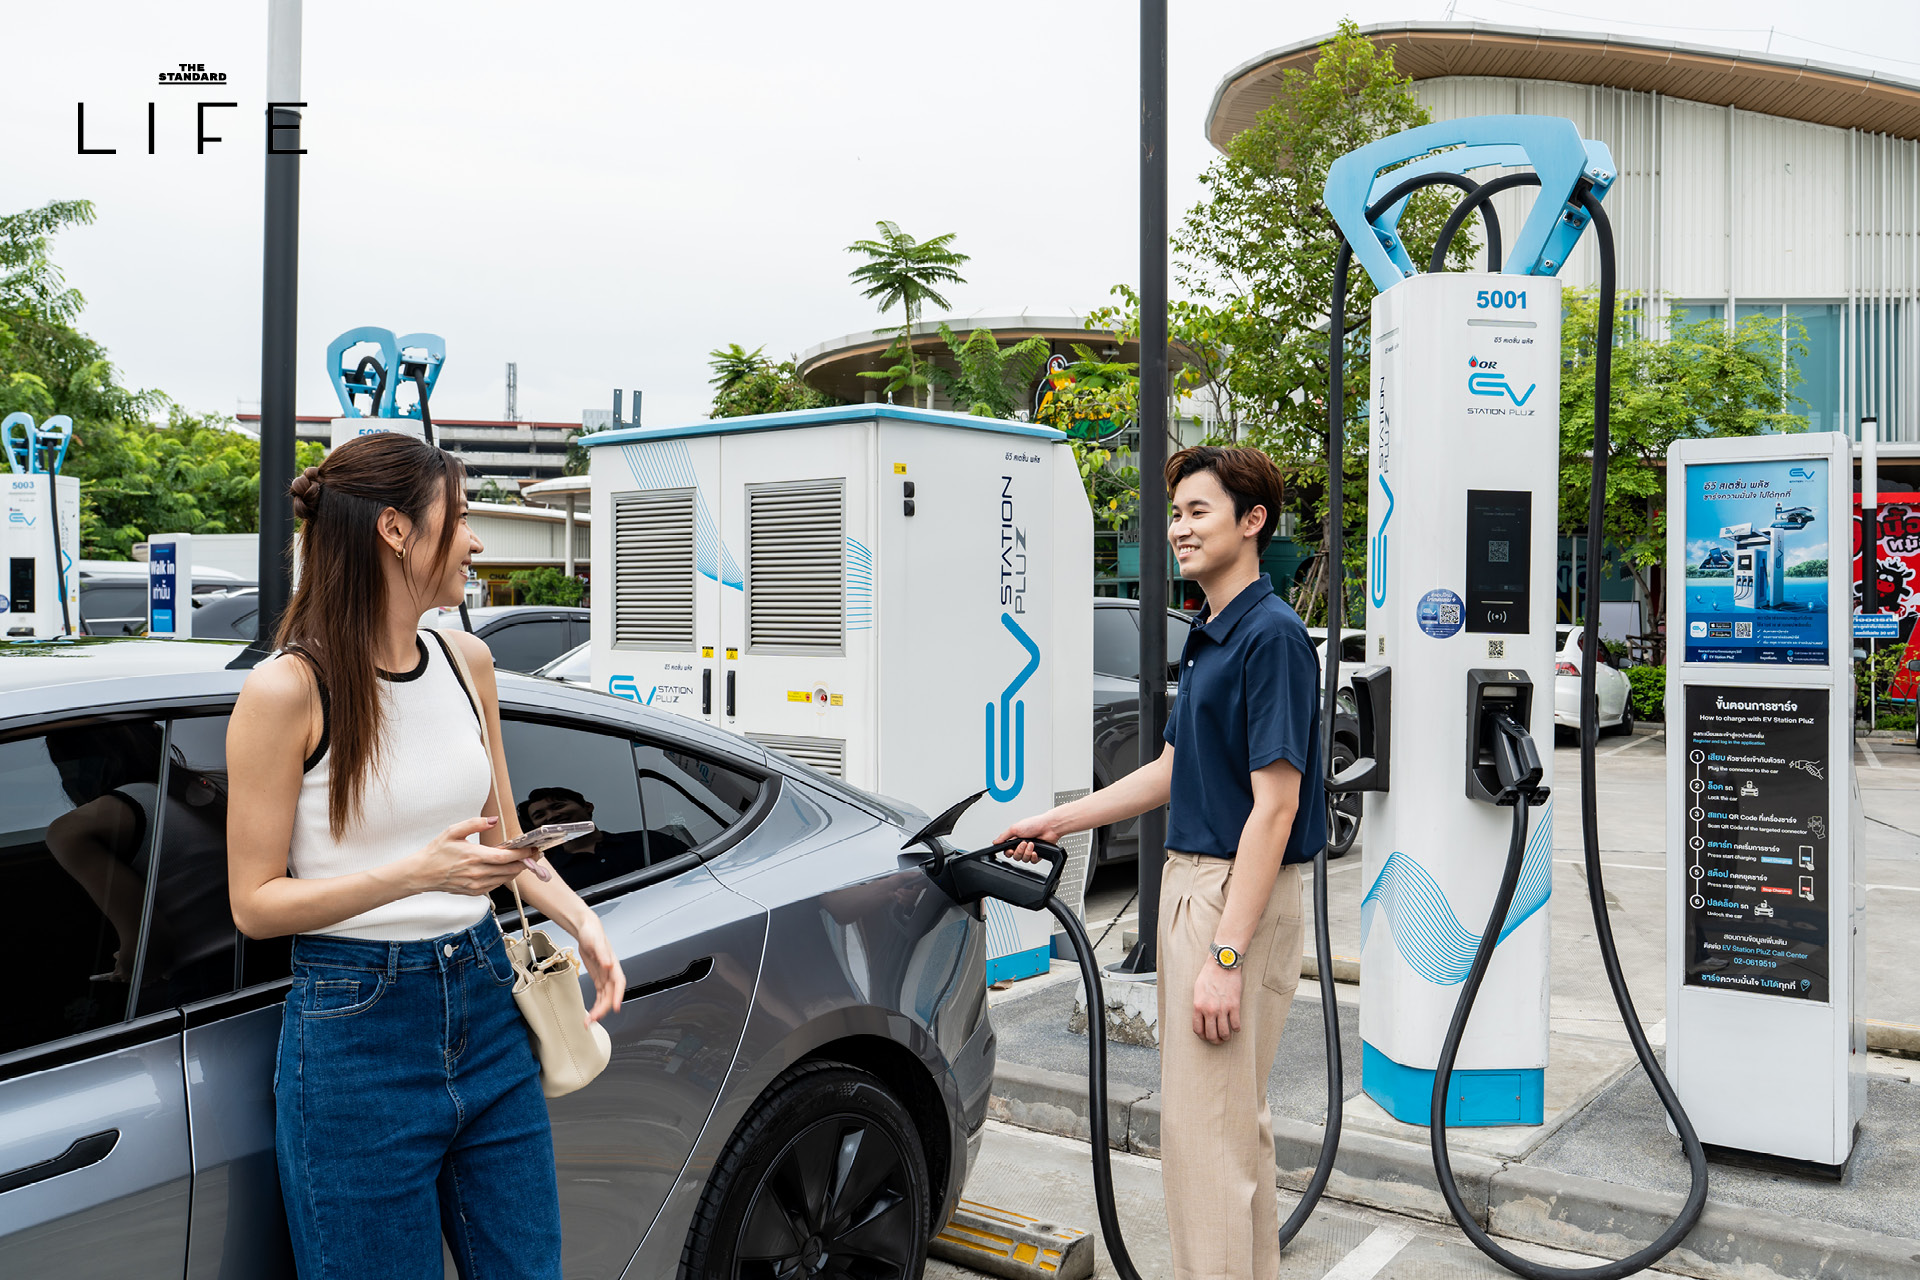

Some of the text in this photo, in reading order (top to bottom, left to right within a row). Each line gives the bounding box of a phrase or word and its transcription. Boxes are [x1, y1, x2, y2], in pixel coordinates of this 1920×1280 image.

[1477, 290, 1526, 309] 5001
[1479, 361, 1498, 369] OR
[1468, 373, 1536, 407] EV
[12, 482, 35, 490] 5003
[1704, 481, 1717, 491] อีวี
[1001, 476, 1013, 606] STATION
[151, 560, 175, 575] Walk in
[1015, 526, 1027, 614] PLUZ
[1508, 672, 1520, 681] A
[658, 686, 694, 694] STATION
[656, 695, 680, 703] PLUZ
[1716, 696, 1798, 712] ขั้นตอนการชาร์จ
[986, 612, 1040, 803] EV
[1723, 715, 1746, 723] charge
[1708, 753, 1726, 761] เสียบ
[1740, 814, 1758, 822] Code
[1734, 854, 1757, 862] charging
[1734, 883, 1756, 891] charging
[1704, 942, 1722, 950] ติดต่อ
[1732, 945, 1755, 954] Station
[1756, 947, 1772, 955] PluZ
[1786, 951, 1808, 960] Center
[1734, 958, 1777, 969] 02-0619519
[1702, 973, 1796, 992] ชาร์จความมั่นใจ ไปได้ทุกที่
